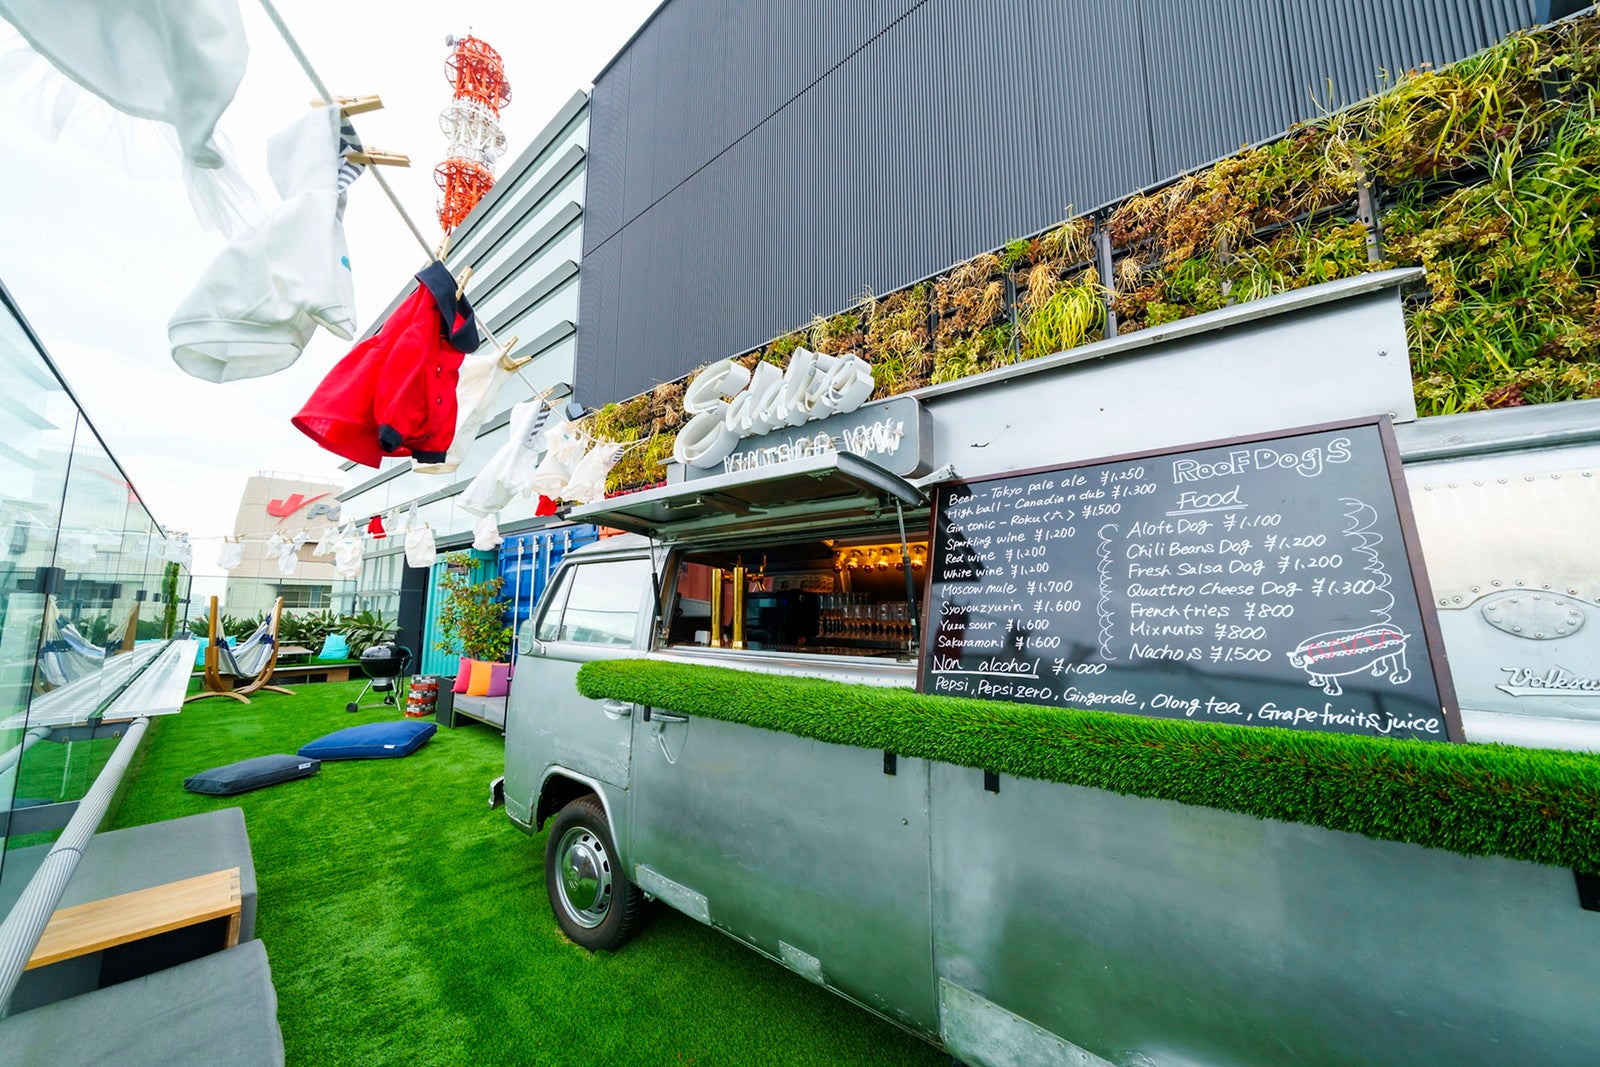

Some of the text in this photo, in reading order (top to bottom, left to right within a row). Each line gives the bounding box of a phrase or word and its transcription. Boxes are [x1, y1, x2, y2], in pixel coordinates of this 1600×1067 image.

[949, 494, 978, 506] Beer
[991, 486, 1023, 499] Tokyo
[1027, 480, 1054, 495] pale
[1061, 474, 1087, 488] ale
[1176, 485, 1242, 510] Food
[1014, 494, 1076, 509] Canadian
[946, 523, 964, 534] Gin
[967, 521, 996, 530] tonic
[1126, 520, 1173, 539] Aloft
[1177, 520, 1213, 535] Dog
[945, 536, 992, 550] Sparkling
[996, 532, 1026, 544] wine
[1127, 544, 1164, 560] Chili
[1169, 541, 1214, 556] Beans
[1219, 540, 1252, 556] Dog
[946, 554, 964, 564] Red
[968, 552, 996, 562] wine
[976, 566, 1004, 576] wine
[1128, 564, 1171, 578] Fresh
[1176, 562, 1223, 576] Salsa
[1228, 560, 1266, 576] Dog
[942, 584, 984, 598] Moscow
[986, 582, 1018, 594] mule
[1126, 584, 1194, 598] Quattro
[1200, 582, 1254, 596] Cheese
[1262, 581, 1302, 597] Dog
[1130, 602, 1294, 620] French fries ¥800
[940, 620, 966, 632] Yuzu
[968, 621, 997, 630] sour
[1214, 624, 1266, 640] ¥800
[932, 654, 964, 672] Non
[978, 657, 1040, 676] alcohol
[1151, 693, 1202, 716] Olong
